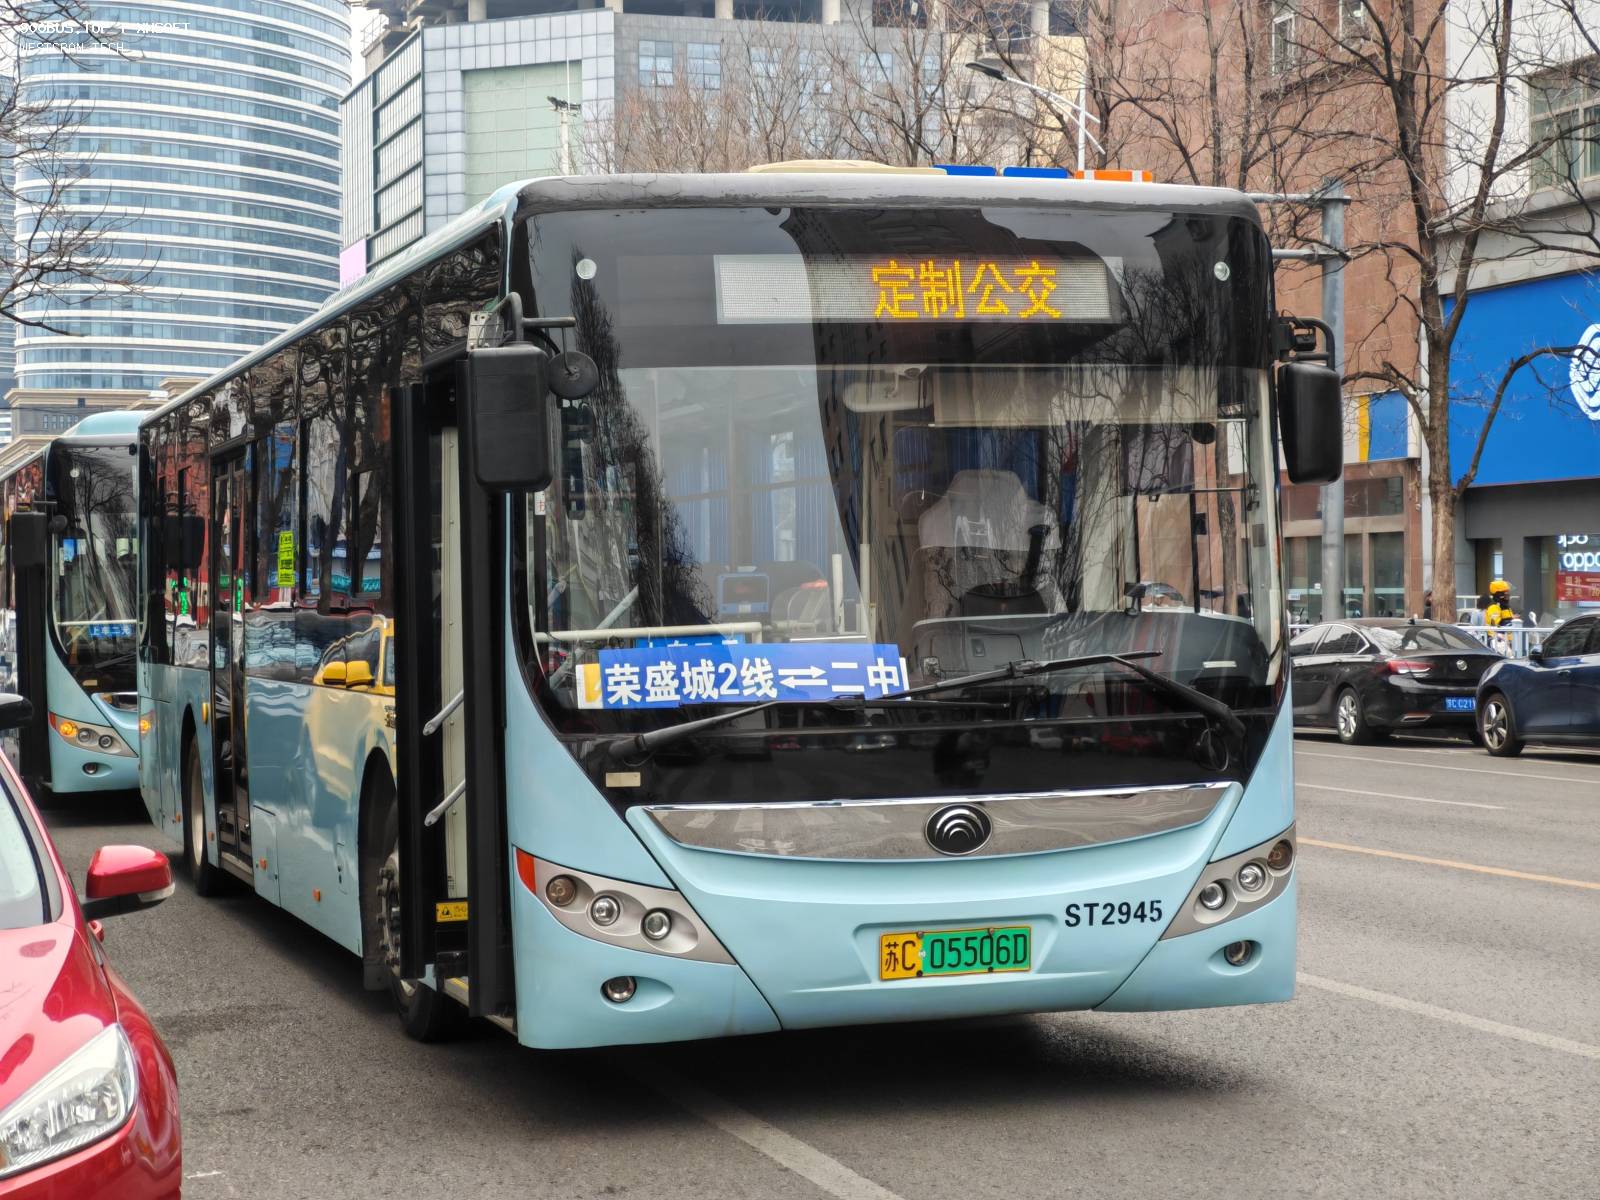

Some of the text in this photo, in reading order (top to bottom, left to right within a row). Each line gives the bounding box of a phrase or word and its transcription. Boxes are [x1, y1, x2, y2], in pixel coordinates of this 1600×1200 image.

[872, 260, 1062, 319] 定制公交
[604, 657, 901, 706] 荣盛城2线 二中
[1064, 899, 1163, 928] ST2945
